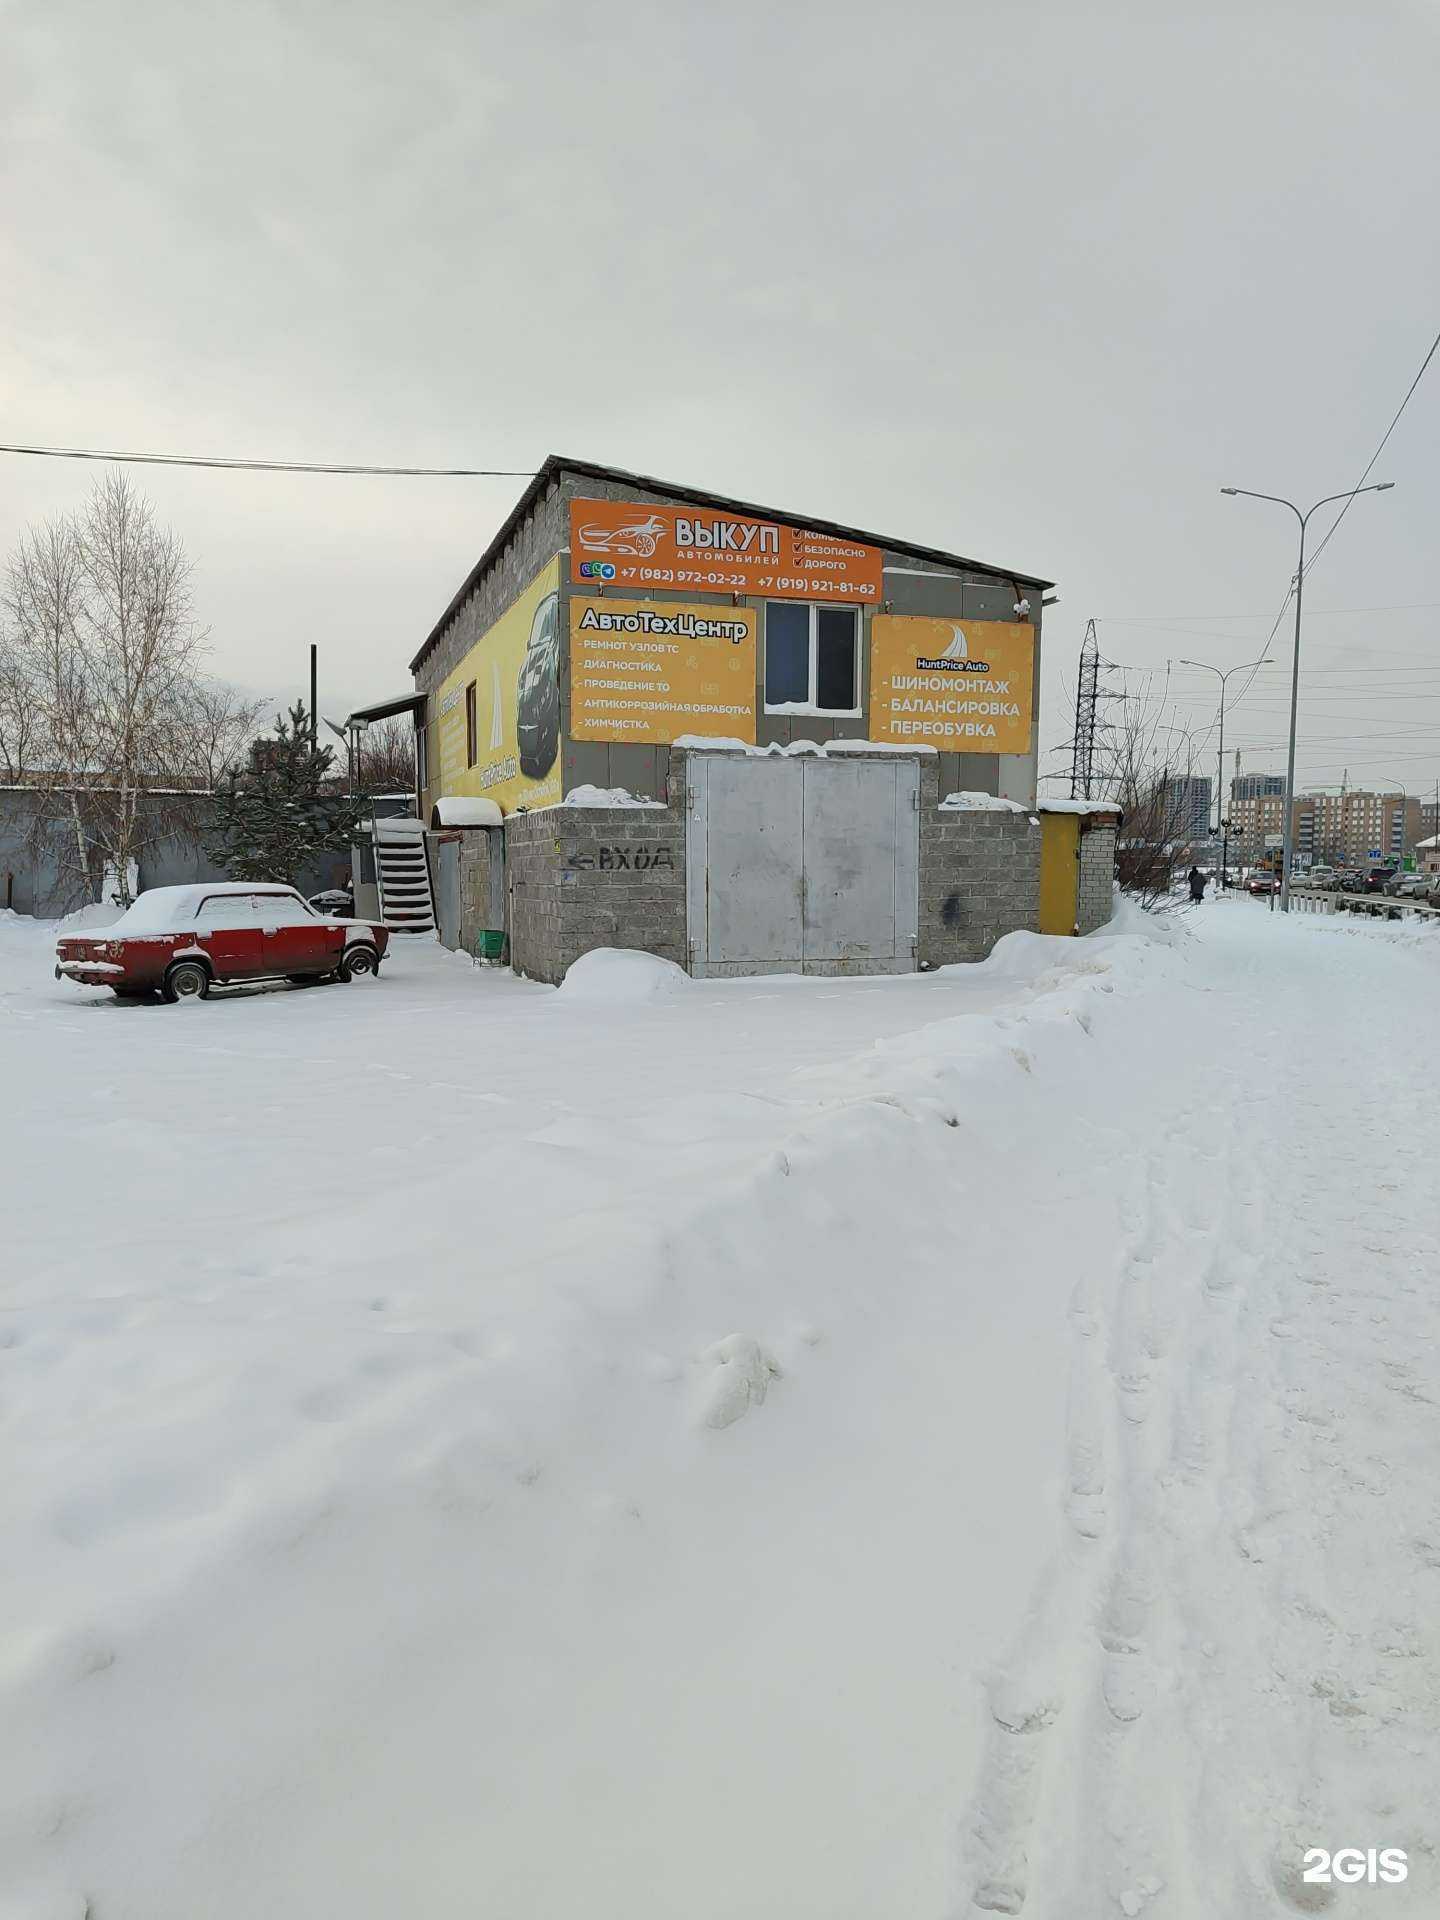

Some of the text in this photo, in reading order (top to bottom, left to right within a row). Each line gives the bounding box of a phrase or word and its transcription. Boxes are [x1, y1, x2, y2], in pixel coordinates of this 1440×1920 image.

[675, 517, 781, 554] ВЫКУП
[676, 550, 780, 566] АВТОМОБИЛЕЙ
[804, 545, 866, 558] БЕЗОПАСНО
[804, 559, 847, 570] ДОРОГО
[620, 567, 747, 586] +7 (982) 972-02-22
[756, 577, 876, 595] +7 (919) 921-81-62
[579, 608, 748, 644] АвтоТехЦентр
[583, 640, 680, 654] РЕМНОТ УЗЛОВ ТС
[583, 659, 663, 672] ДИАГНОСТИКА
[917, 659, 988, 671] HuntPrice Auto
[584, 679, 670, 692] ПРОВЕДЕНИЕ ТО
[891, 675, 1010, 694] ШИНОМОНТАЖ
[584, 699, 752, 715] АНТИКОРРОЗИЙНАЯ ОБРАБОТКА
[890, 699, 1021, 716] БАЛАНСИРОВКА
[584, 718, 650, 729] ХИМЧИСТКА
[890, 721, 996, 737] ПЕРЕОБУВКА
